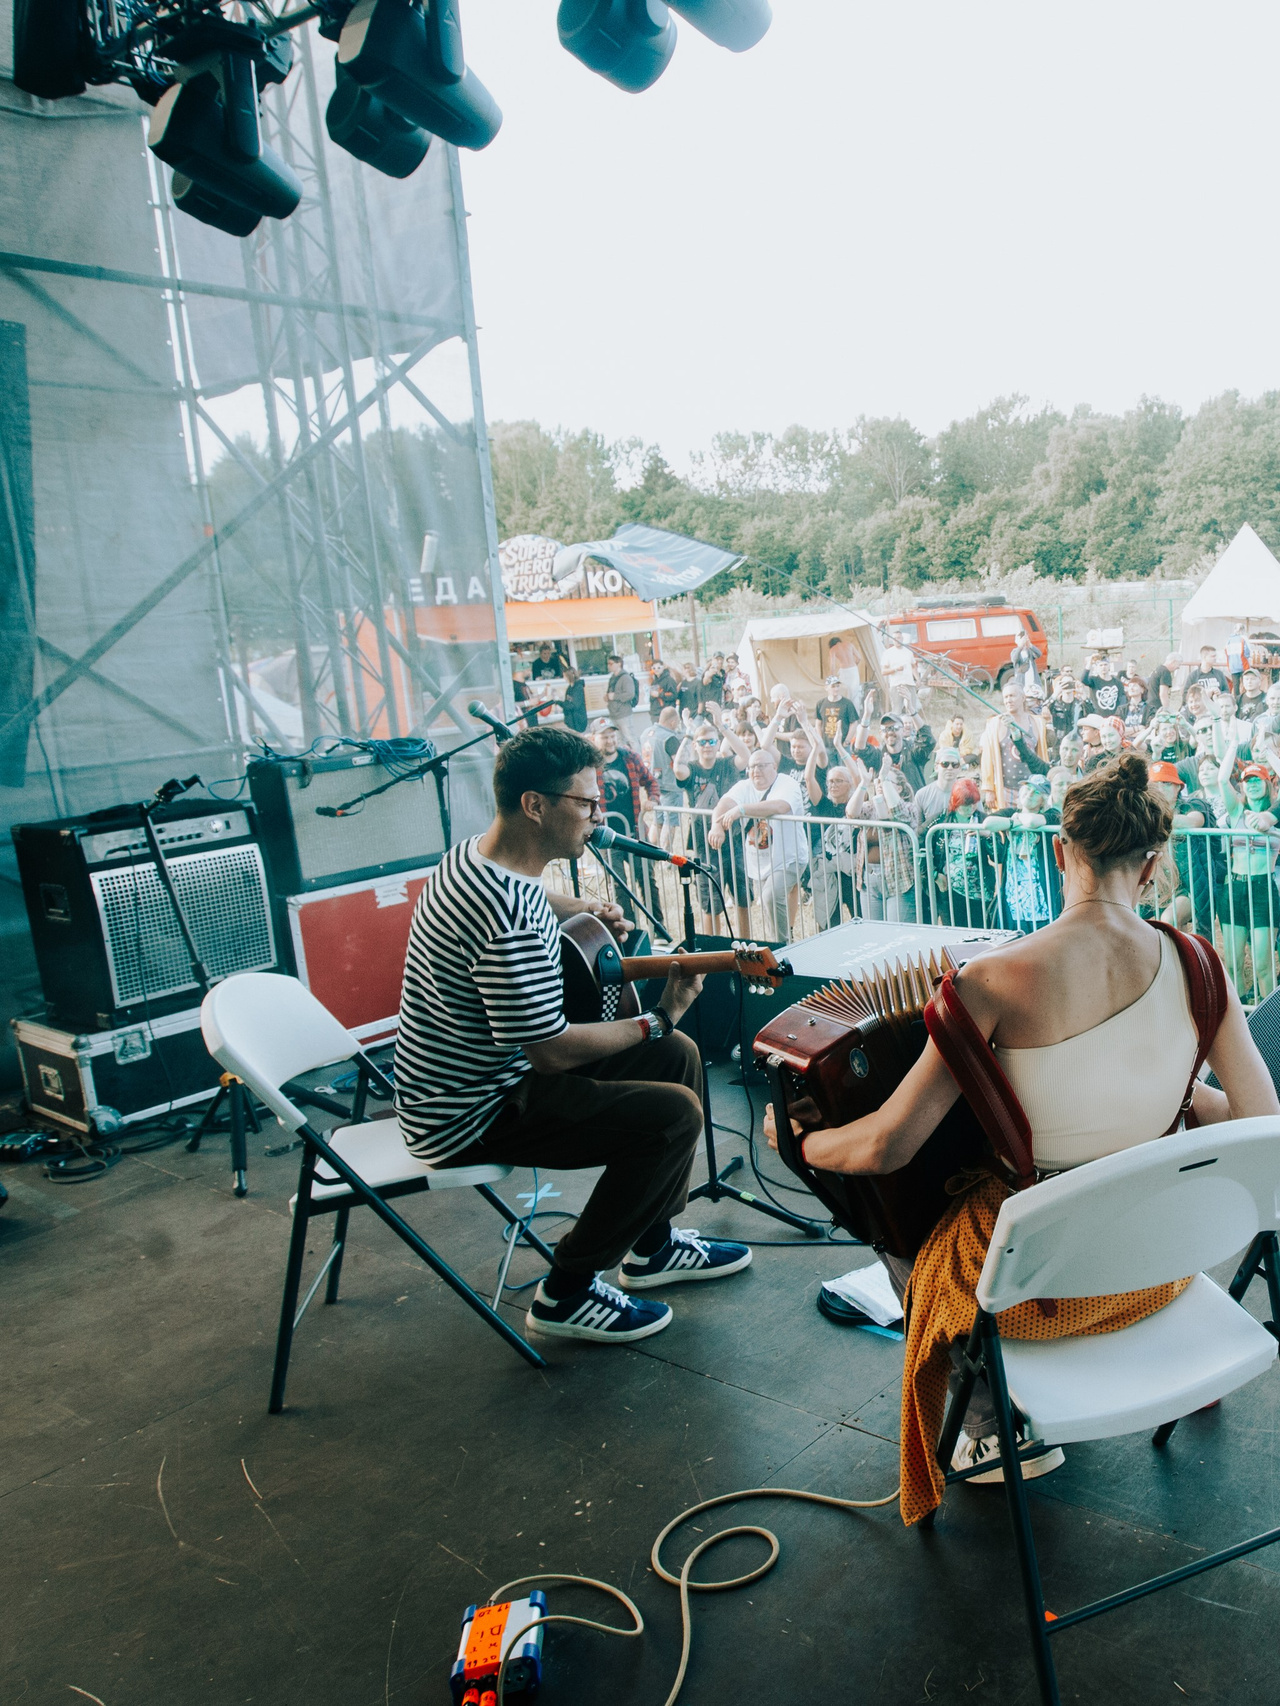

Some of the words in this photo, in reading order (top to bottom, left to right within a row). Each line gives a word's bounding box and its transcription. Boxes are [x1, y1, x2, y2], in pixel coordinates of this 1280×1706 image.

[505, 541, 557, 566] SUPER
[514, 557, 553, 576] HERO
[409, 575, 487, 605] ЕДА
